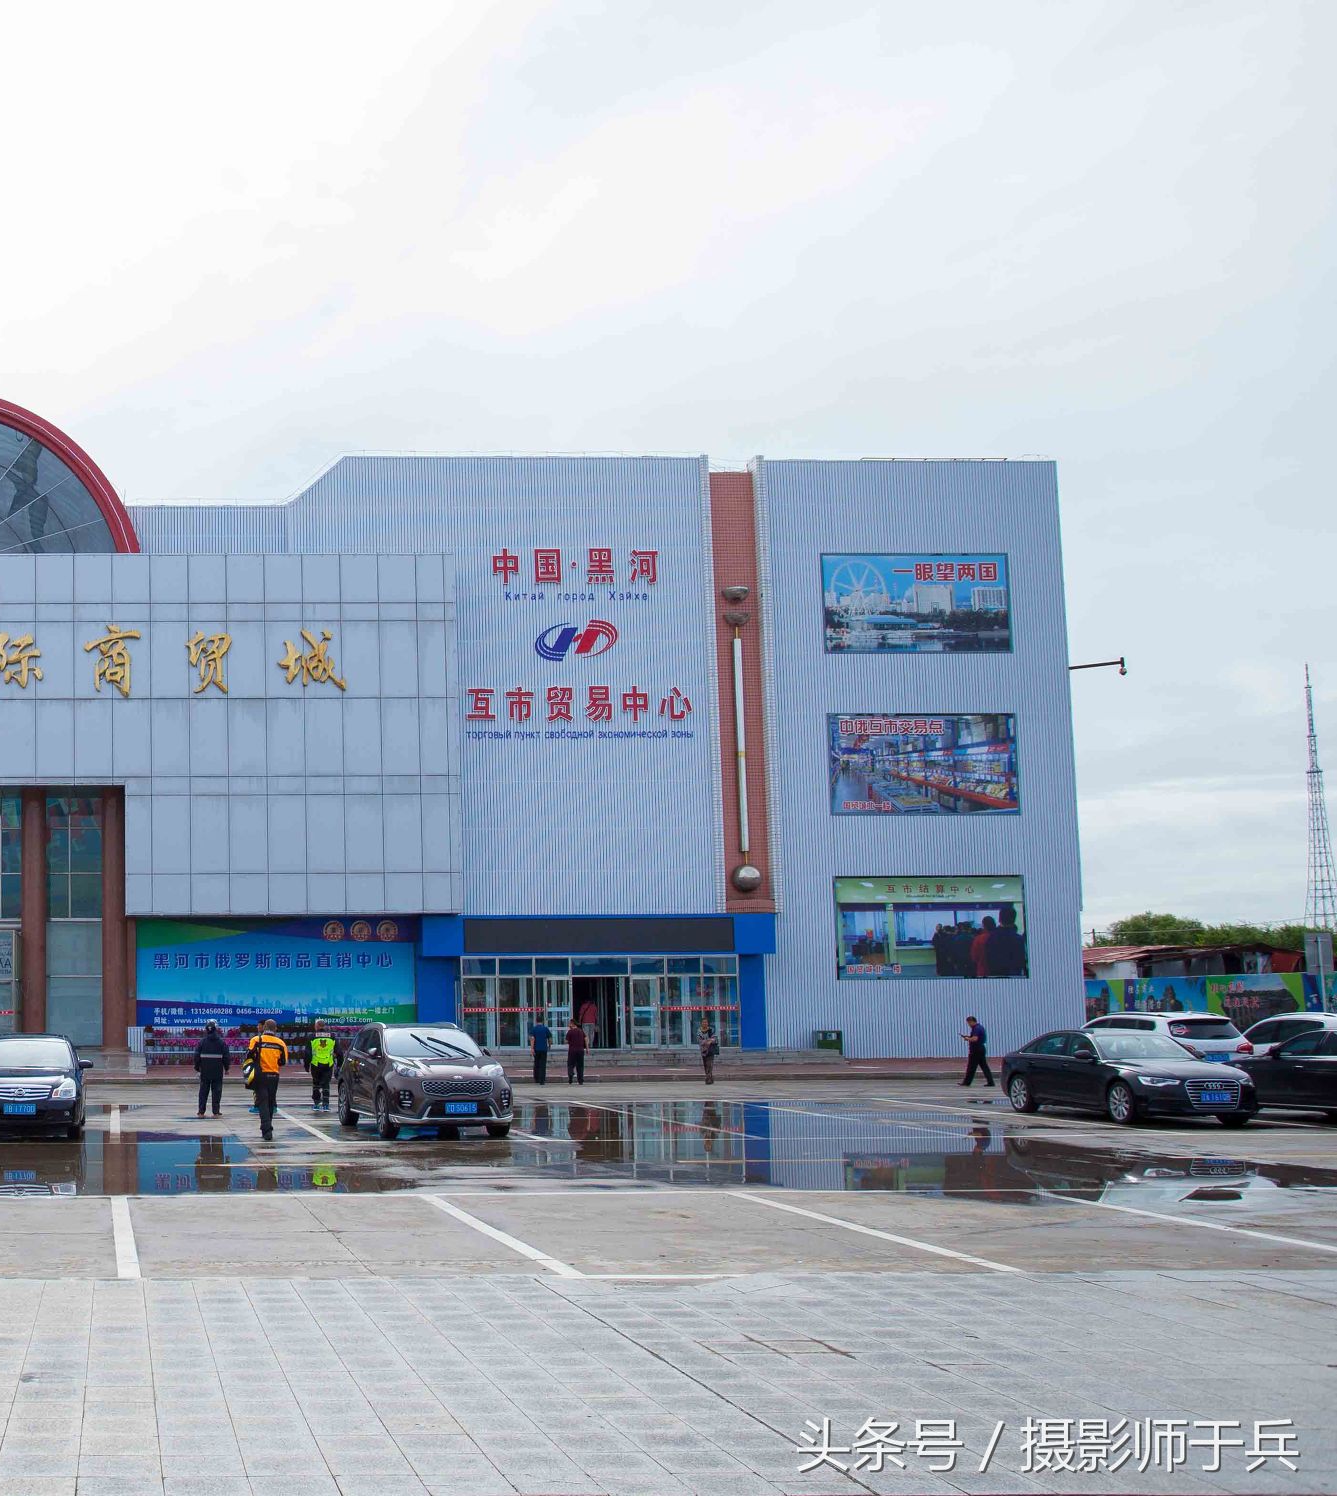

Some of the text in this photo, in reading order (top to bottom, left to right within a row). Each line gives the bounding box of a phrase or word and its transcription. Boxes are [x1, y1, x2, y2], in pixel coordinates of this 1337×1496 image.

[492, 548, 659, 585] 中国·黑河
[893, 561, 998, 582] 一眼望两国
[505, 591, 648, 602] Китай город Хэйхе
[466, 685, 693, 722] 互市贸易中心
[466, 730, 512, 740] торговый
[514, 731, 541, 740] пункт
[840, 719, 945, 735] 中俄互市交易点
[152, 952, 395, 970] 黑河市俄罗斯商品直销中心
